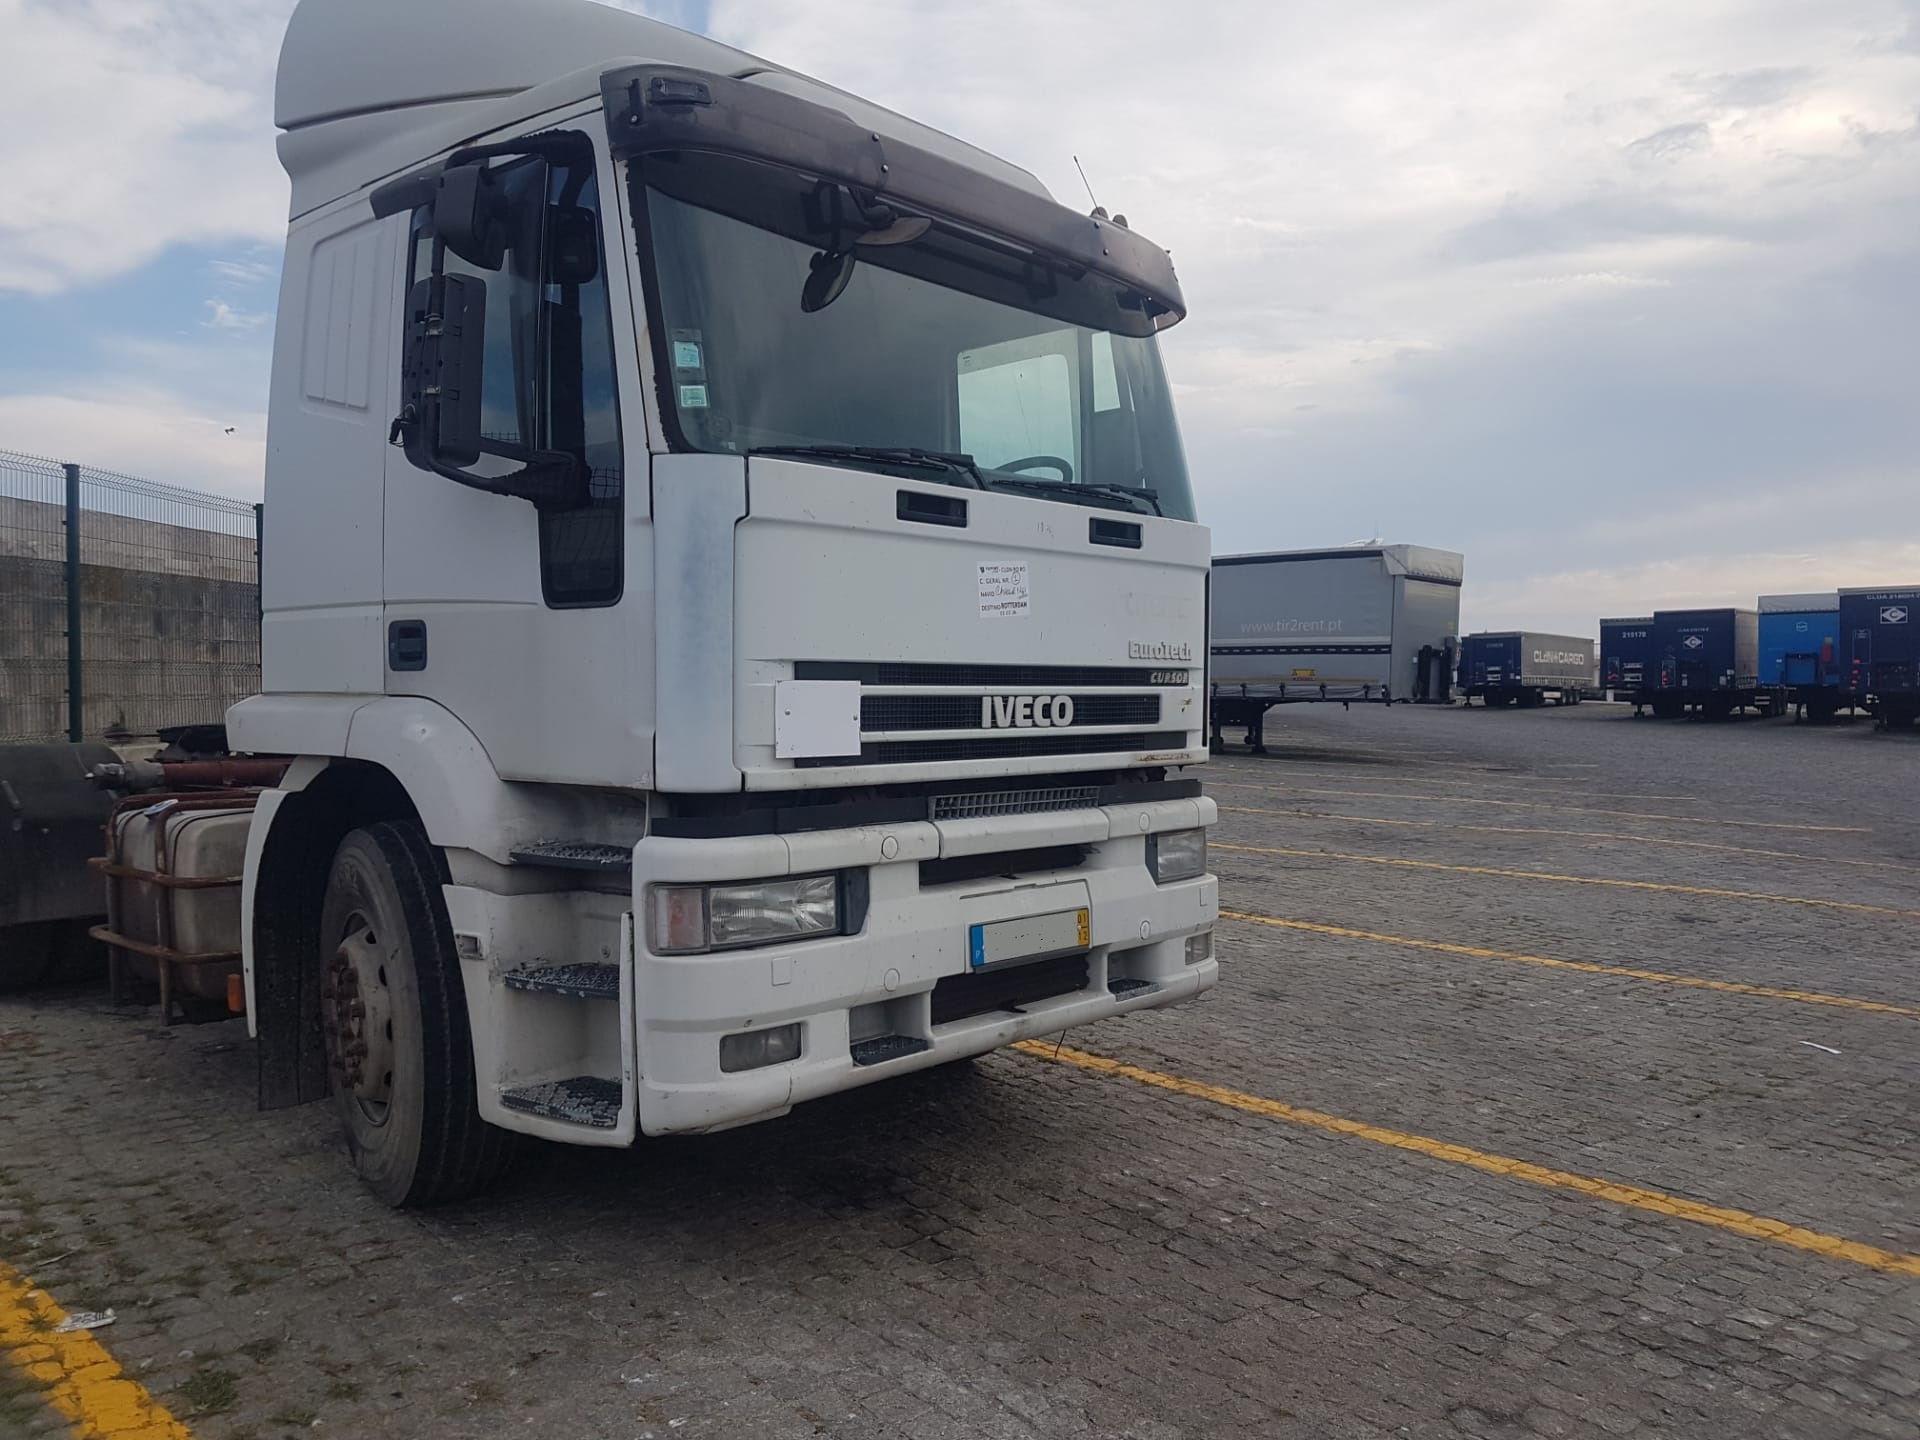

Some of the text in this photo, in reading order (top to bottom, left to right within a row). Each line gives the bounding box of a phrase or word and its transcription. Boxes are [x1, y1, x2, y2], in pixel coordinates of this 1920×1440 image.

[1240, 619, 1344, 633] www.tir2rent.pt
[1558, 651, 1584, 665] CARGO
[981, 695, 1074, 729] IVECO
